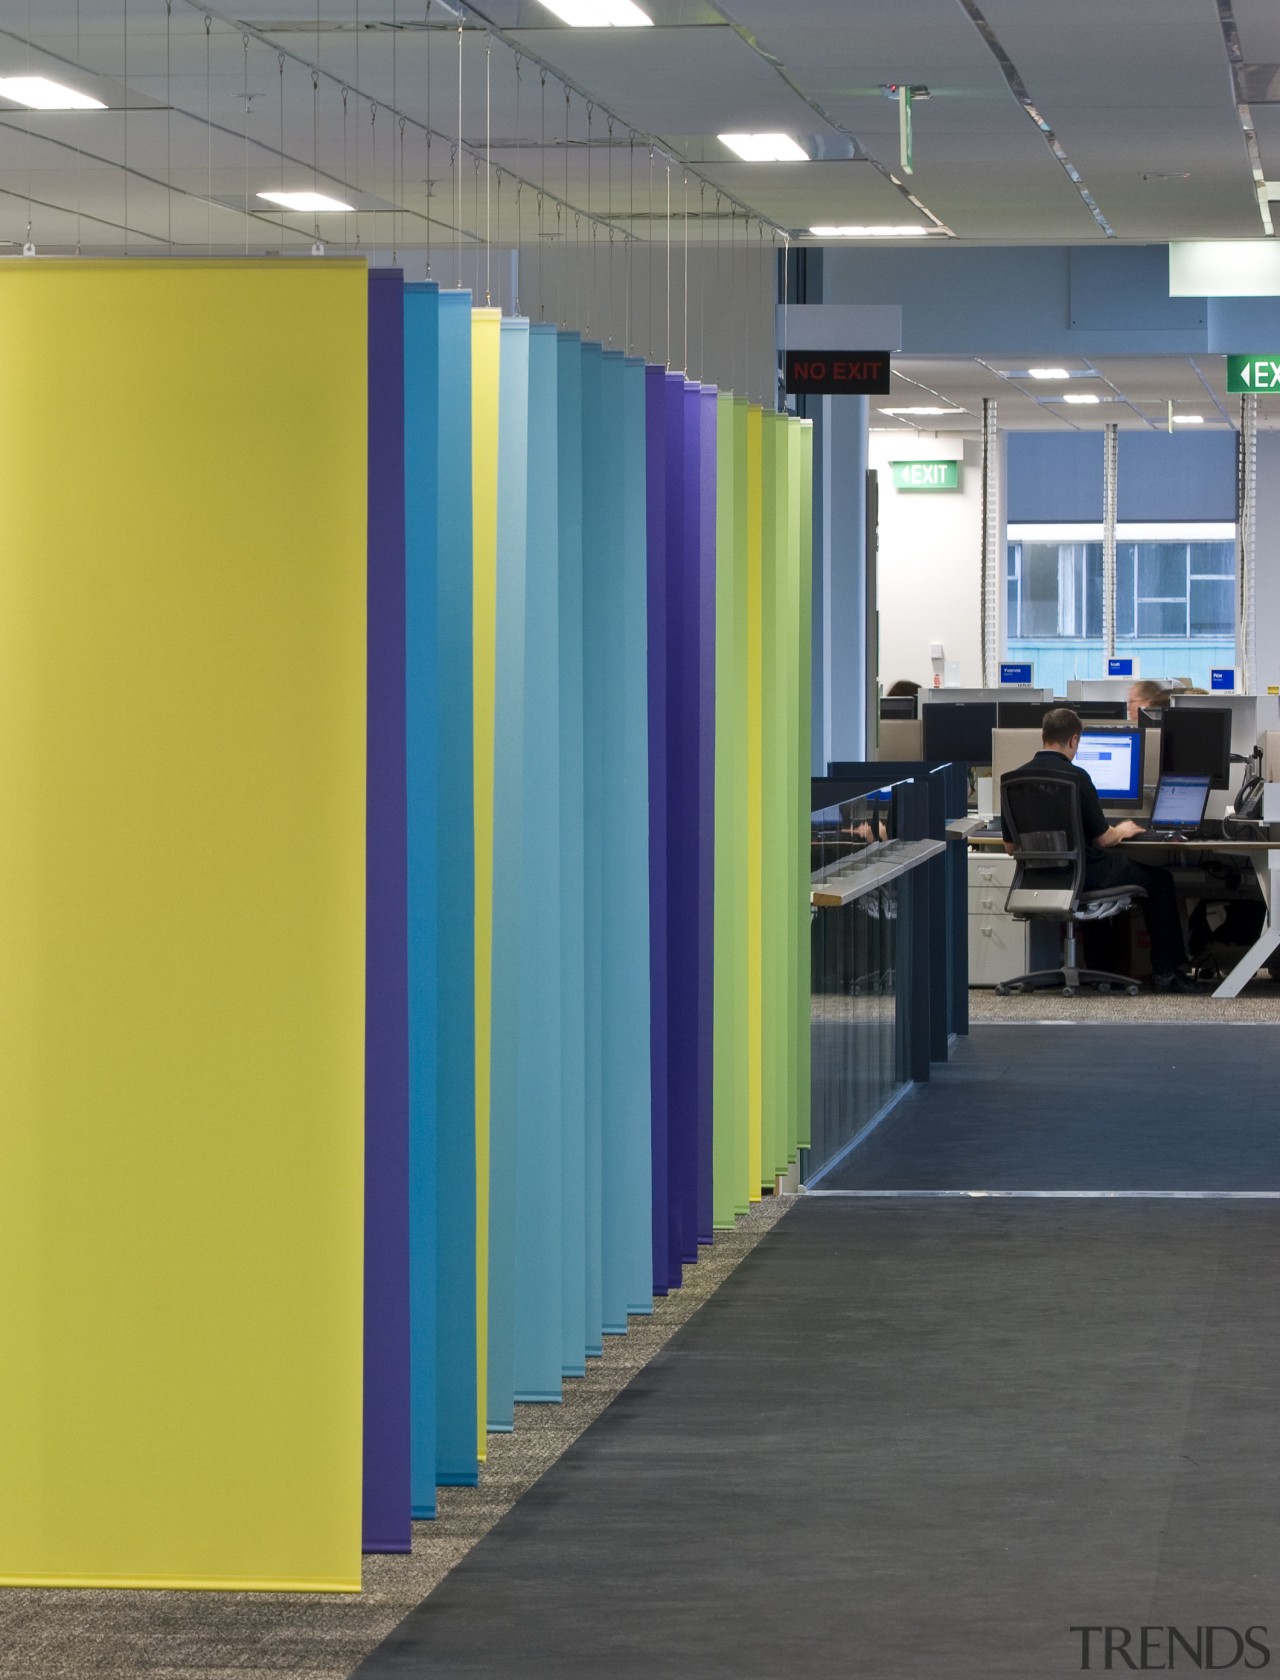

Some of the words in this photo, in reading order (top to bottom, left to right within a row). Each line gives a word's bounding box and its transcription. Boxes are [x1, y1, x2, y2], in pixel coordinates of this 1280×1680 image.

[794, 362, 826, 380] NO
[833, 362, 882, 380] EXIT
[911, 464, 948, 484] EXIT
